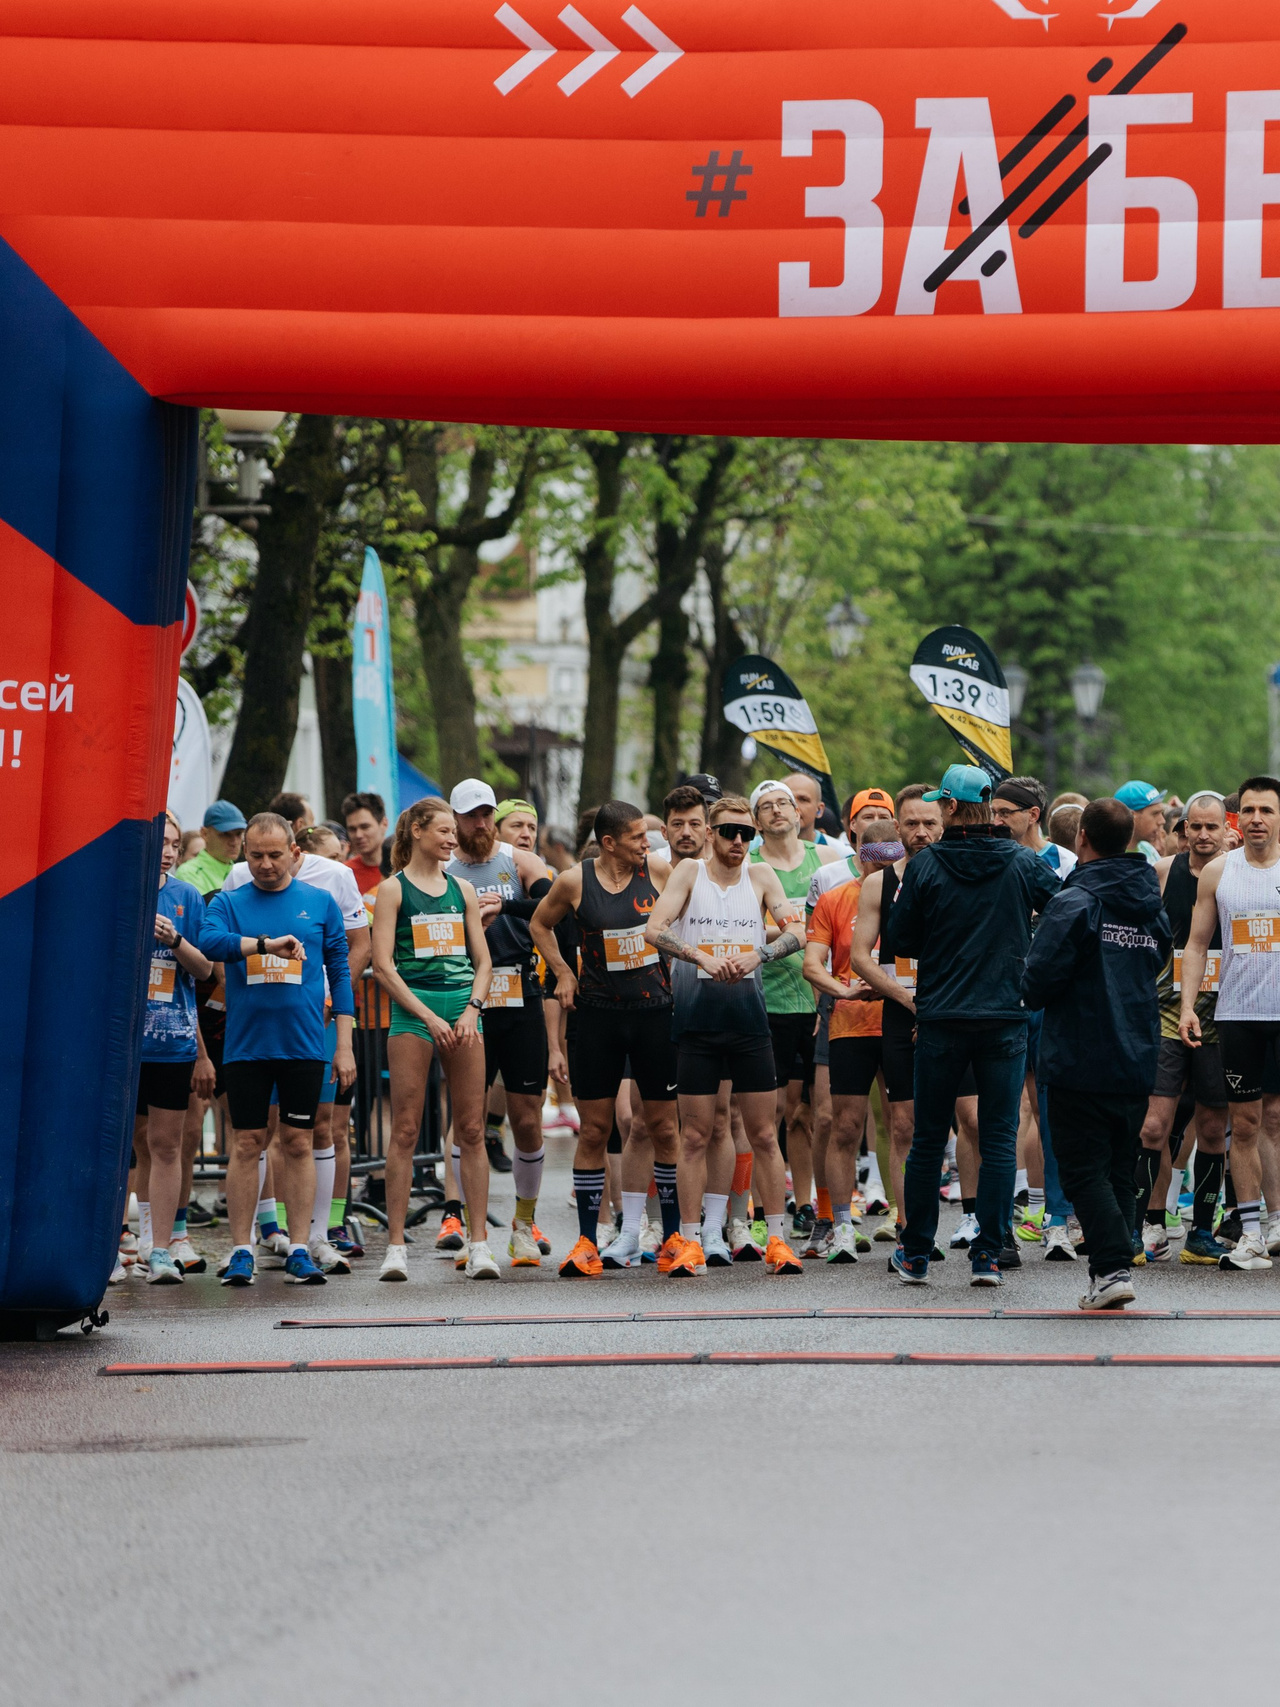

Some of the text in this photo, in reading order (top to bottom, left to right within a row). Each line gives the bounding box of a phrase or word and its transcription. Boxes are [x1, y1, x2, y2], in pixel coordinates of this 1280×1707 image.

[942, 644, 966, 656] RUN
[958, 657, 980, 671] LAB
[740, 672, 759, 685] RUN
[757, 680, 775, 690] LAB
[929, 674, 981, 708] 1:39
[740, 702, 785, 725] 1:59
[950, 713, 967, 724] 4:42
[716, 919, 729, 928] WE
[1102, 923, 1138, 933] company
[1247, 919, 1274, 938] 1661
[427, 923, 454, 941] 1663
[618, 934, 645, 956] 2010
